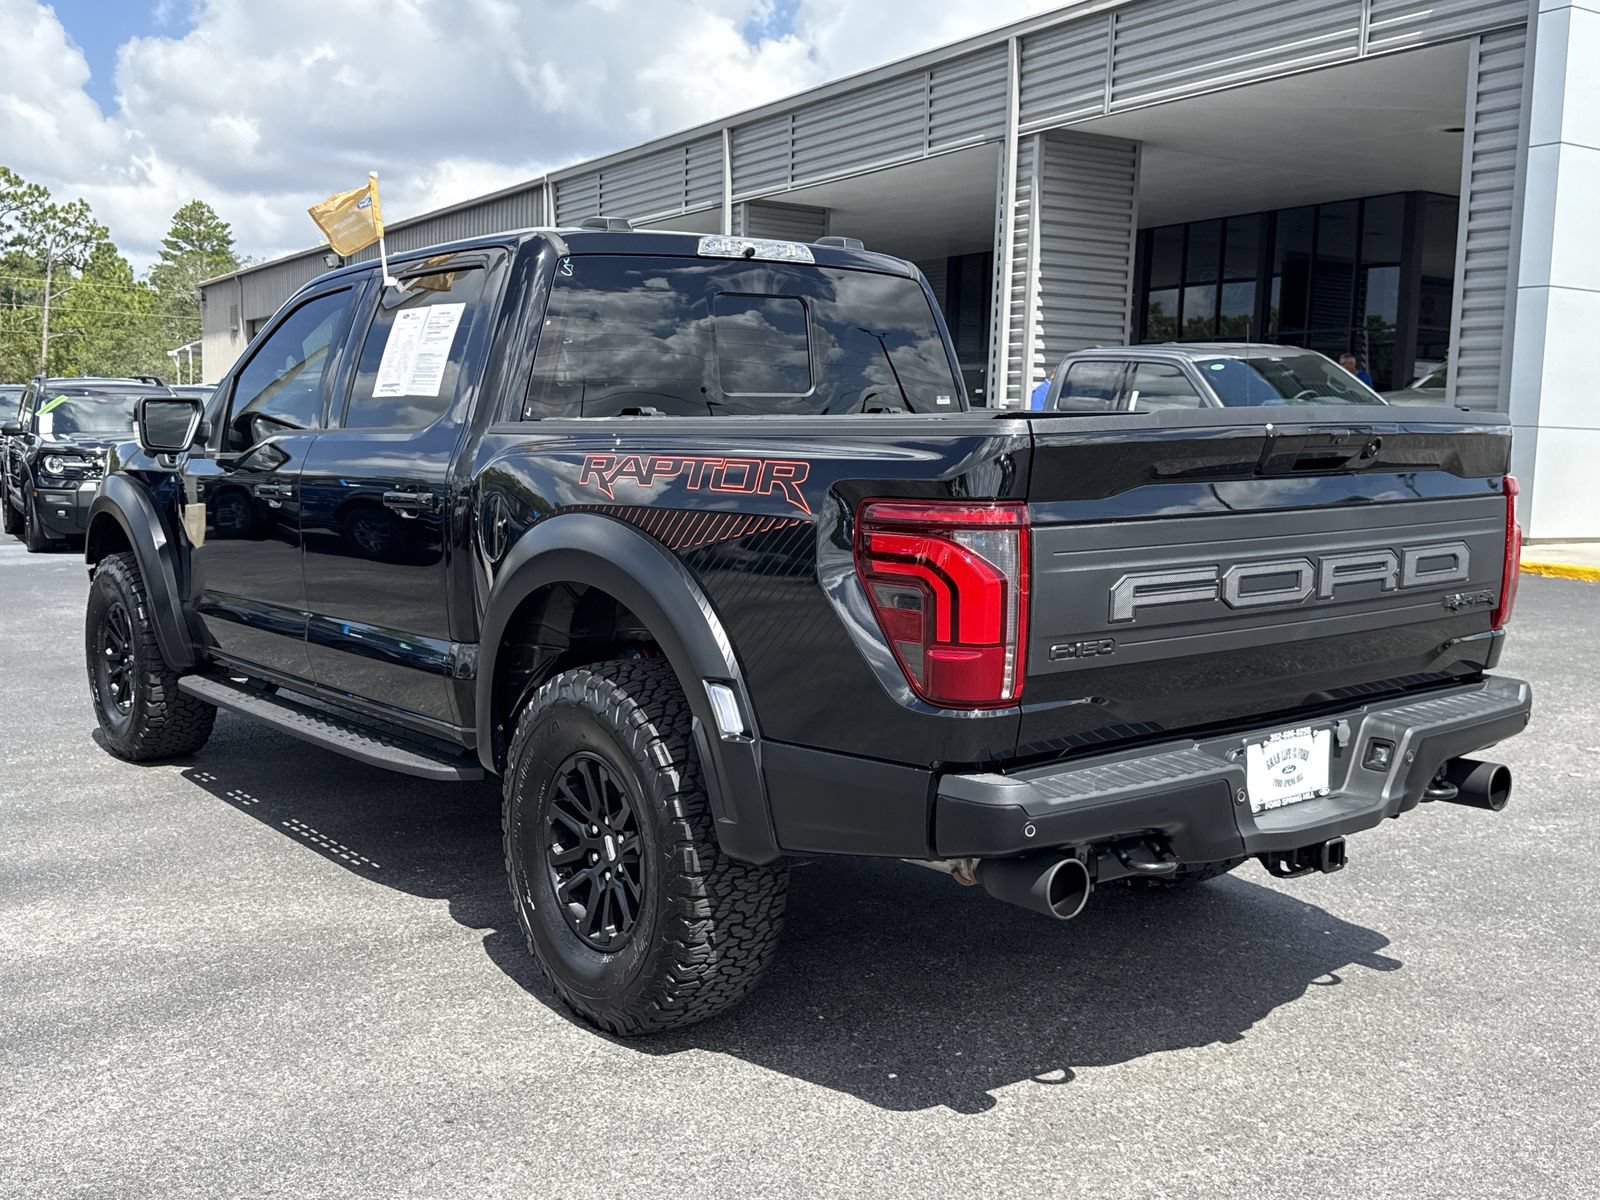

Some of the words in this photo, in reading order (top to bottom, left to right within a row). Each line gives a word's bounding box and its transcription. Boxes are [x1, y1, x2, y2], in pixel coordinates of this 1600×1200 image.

[579, 452, 811, 516] RAPTOR
[1108, 539, 1472, 624] FORD
[1264, 799, 1282, 810] FORD
[1281, 794, 1303, 806] SPRING
[1302, 791, 1316, 800] HILL
